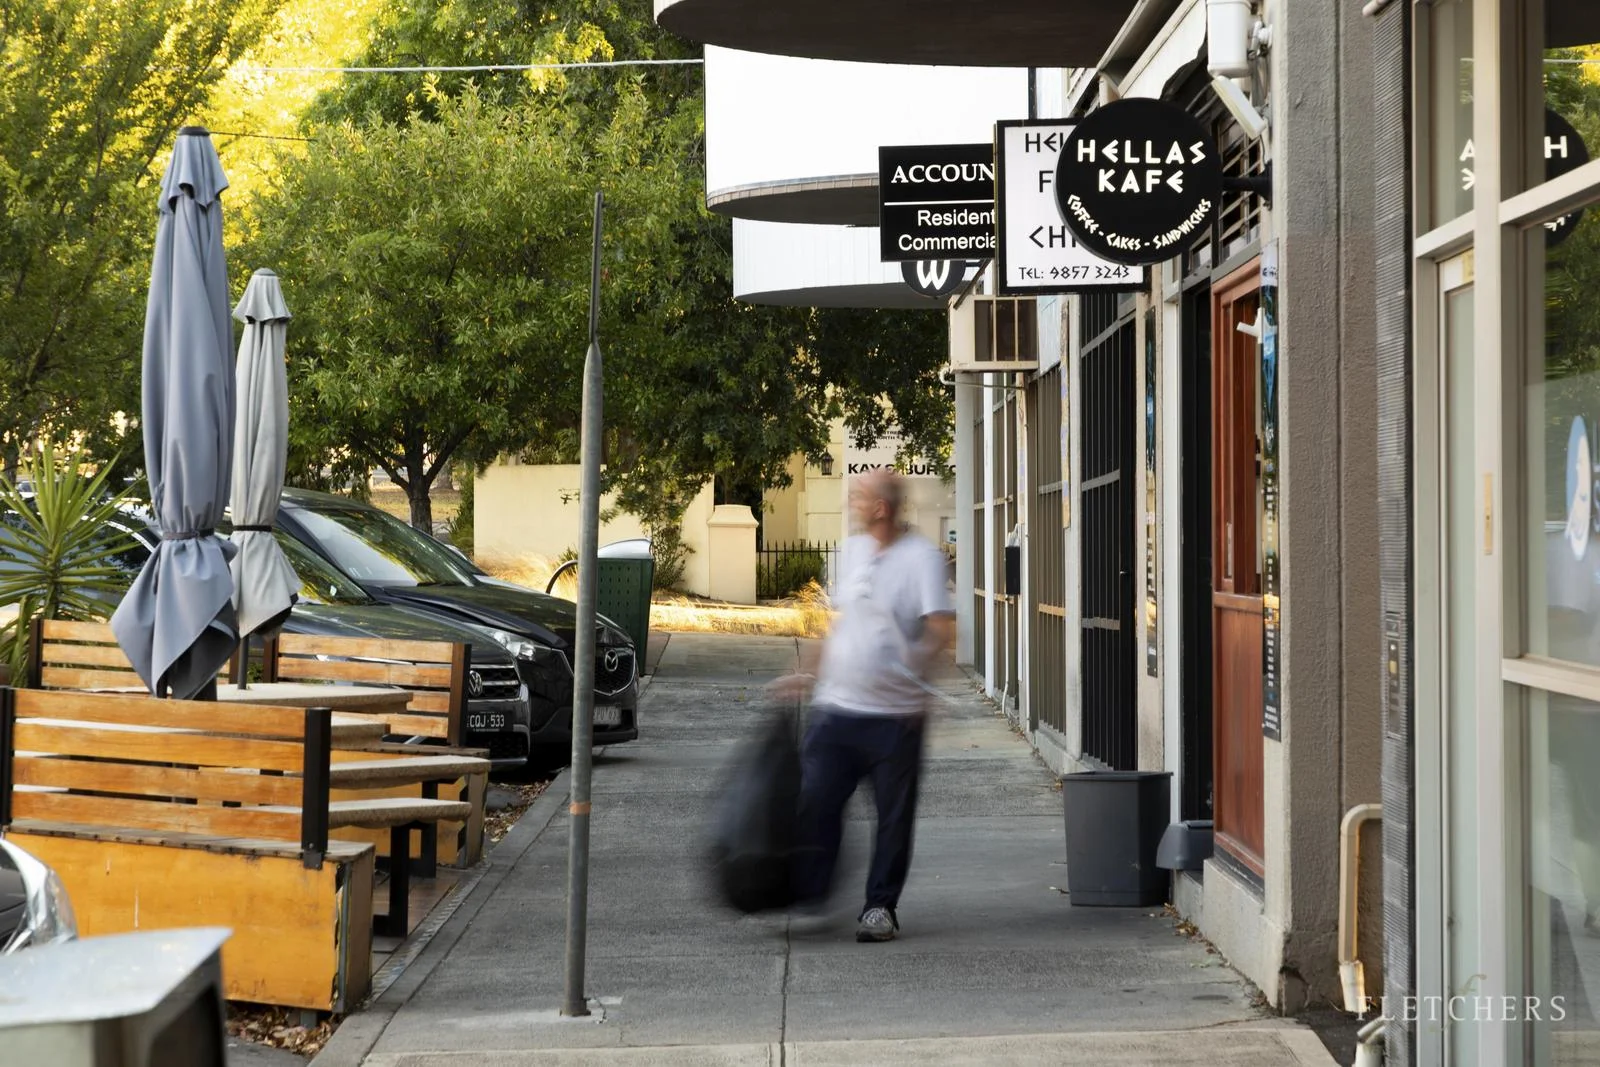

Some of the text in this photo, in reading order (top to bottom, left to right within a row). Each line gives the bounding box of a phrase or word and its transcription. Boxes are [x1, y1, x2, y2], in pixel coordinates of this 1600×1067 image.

[1077, 138, 1206, 164] HELLAS
[1098, 168, 1184, 194] KAFE
[1067, 194, 1099, 234] COFFEE
[1106, 232, 1141, 251] CAKES
[1152, 198, 1212, 250] SANDWICHES
[1019, 263, 1130, 280] TEL: 9857 3243
